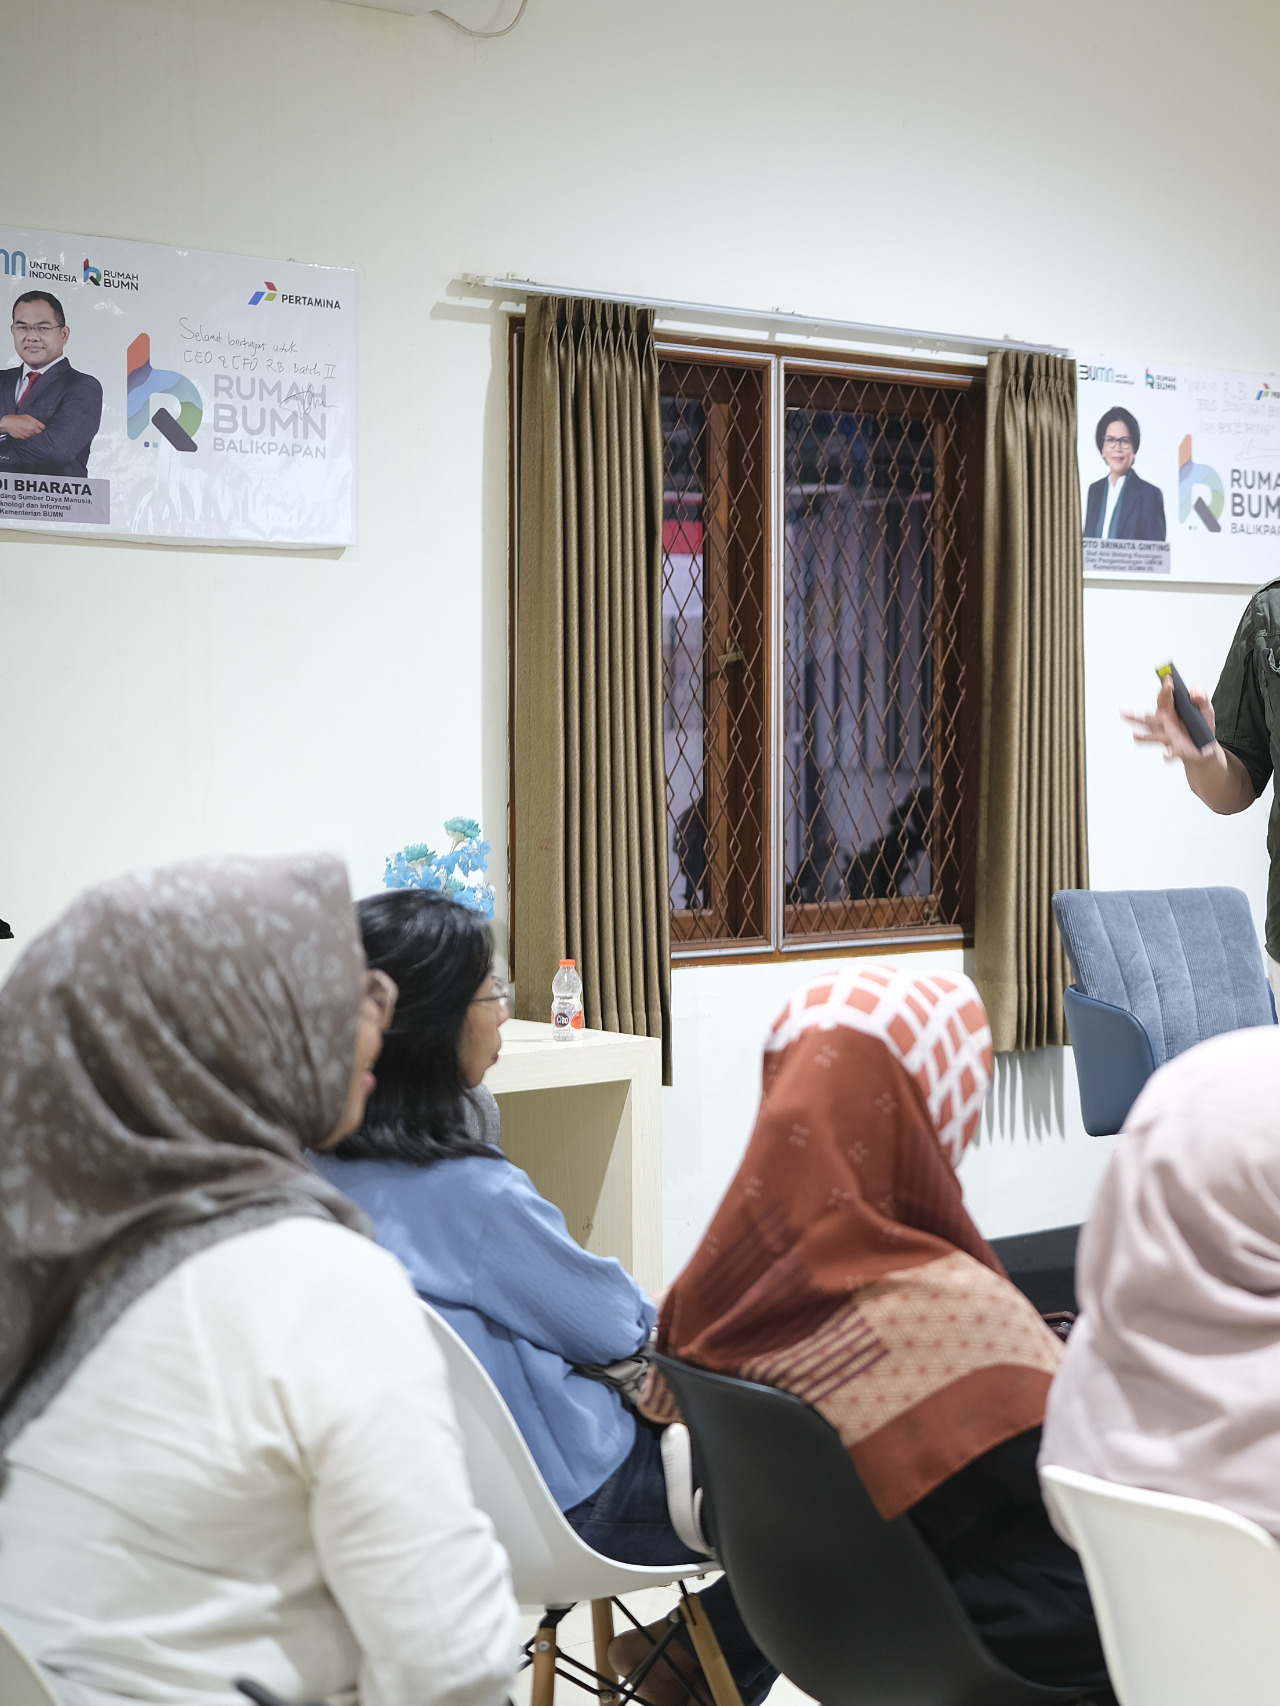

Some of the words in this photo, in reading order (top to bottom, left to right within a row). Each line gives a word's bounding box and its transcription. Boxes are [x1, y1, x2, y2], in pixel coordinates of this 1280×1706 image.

[29, 261, 61, 272] UNTUK
[29, 270, 78, 283] INDONESIA
[103, 270, 139, 282] RUMAH
[103, 279, 139, 291] BUMN
[281, 294, 341, 309] PERTAMINA
[183, 350, 213, 364] CEO
[231, 354, 259, 372] CFO
[213, 373, 327, 407] RUMAH
[213, 403, 327, 441] BUMN
[213, 437, 326, 459] BALIKPAPAN
[14, 479, 92, 496] BHARATA
[18, 493, 44, 501] Sumber
[0, 508, 41, 517] Kementerian
